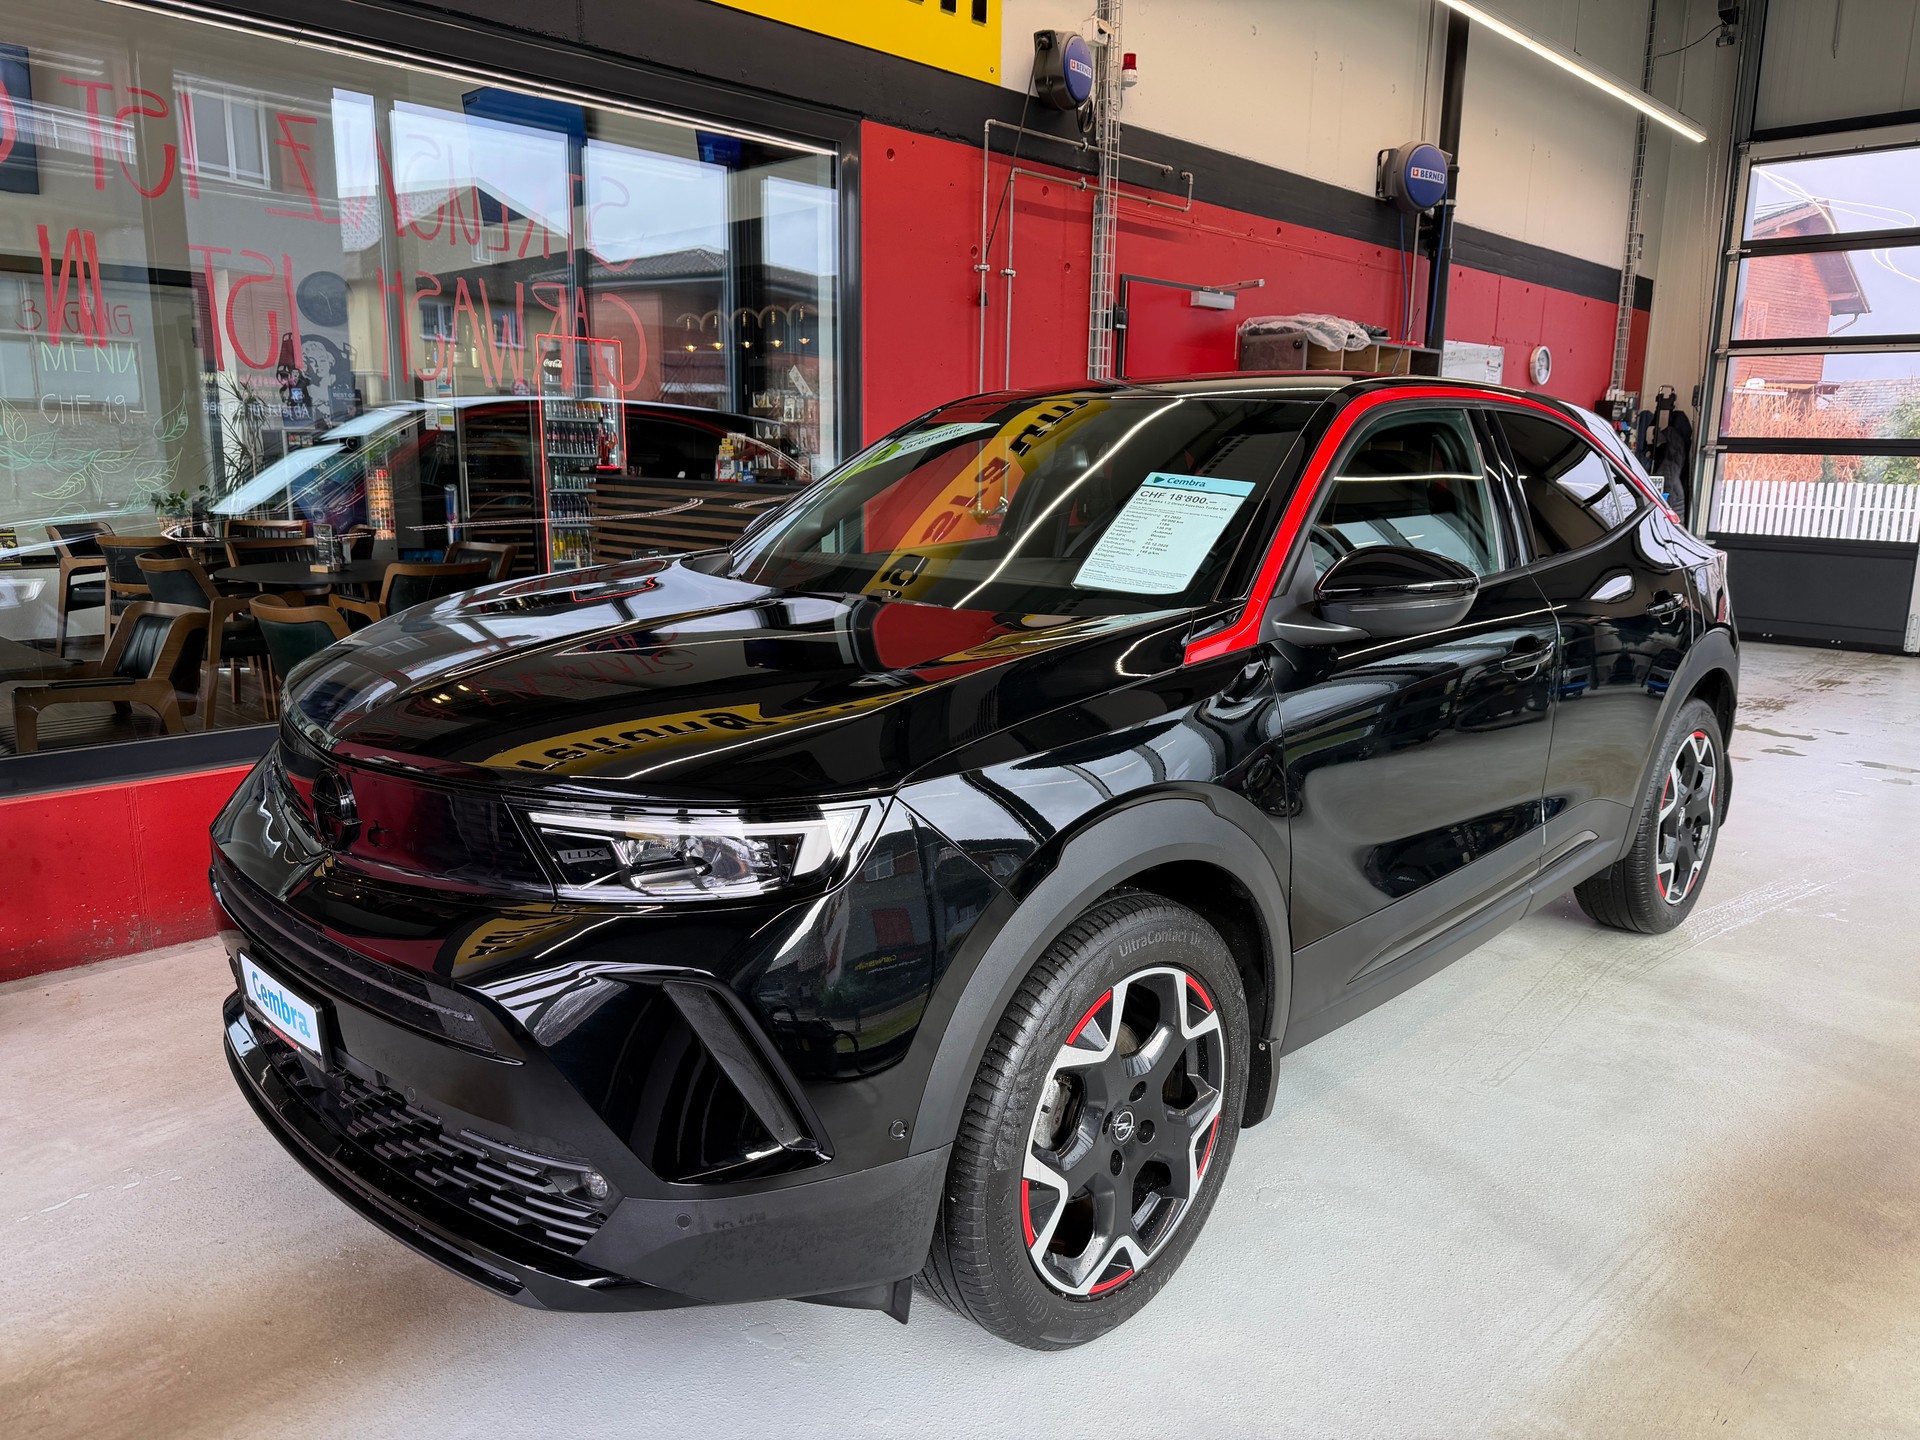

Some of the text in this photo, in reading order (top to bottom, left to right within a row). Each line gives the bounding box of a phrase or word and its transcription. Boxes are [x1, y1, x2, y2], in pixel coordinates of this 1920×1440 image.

[1420, 169, 1444, 183] BERNER
[15, 299, 43, 331] 3
[40, 341, 138, 374] MENU
[40, 393, 91, 425] CHF
[1140, 490, 1166, 500] CHF
[1167, 477, 1206, 488] Cembra
[567, 849, 604, 860] LUX
[1118, 930, 1188, 958] UltraContact
[252, 970, 311, 1038] Cembra
